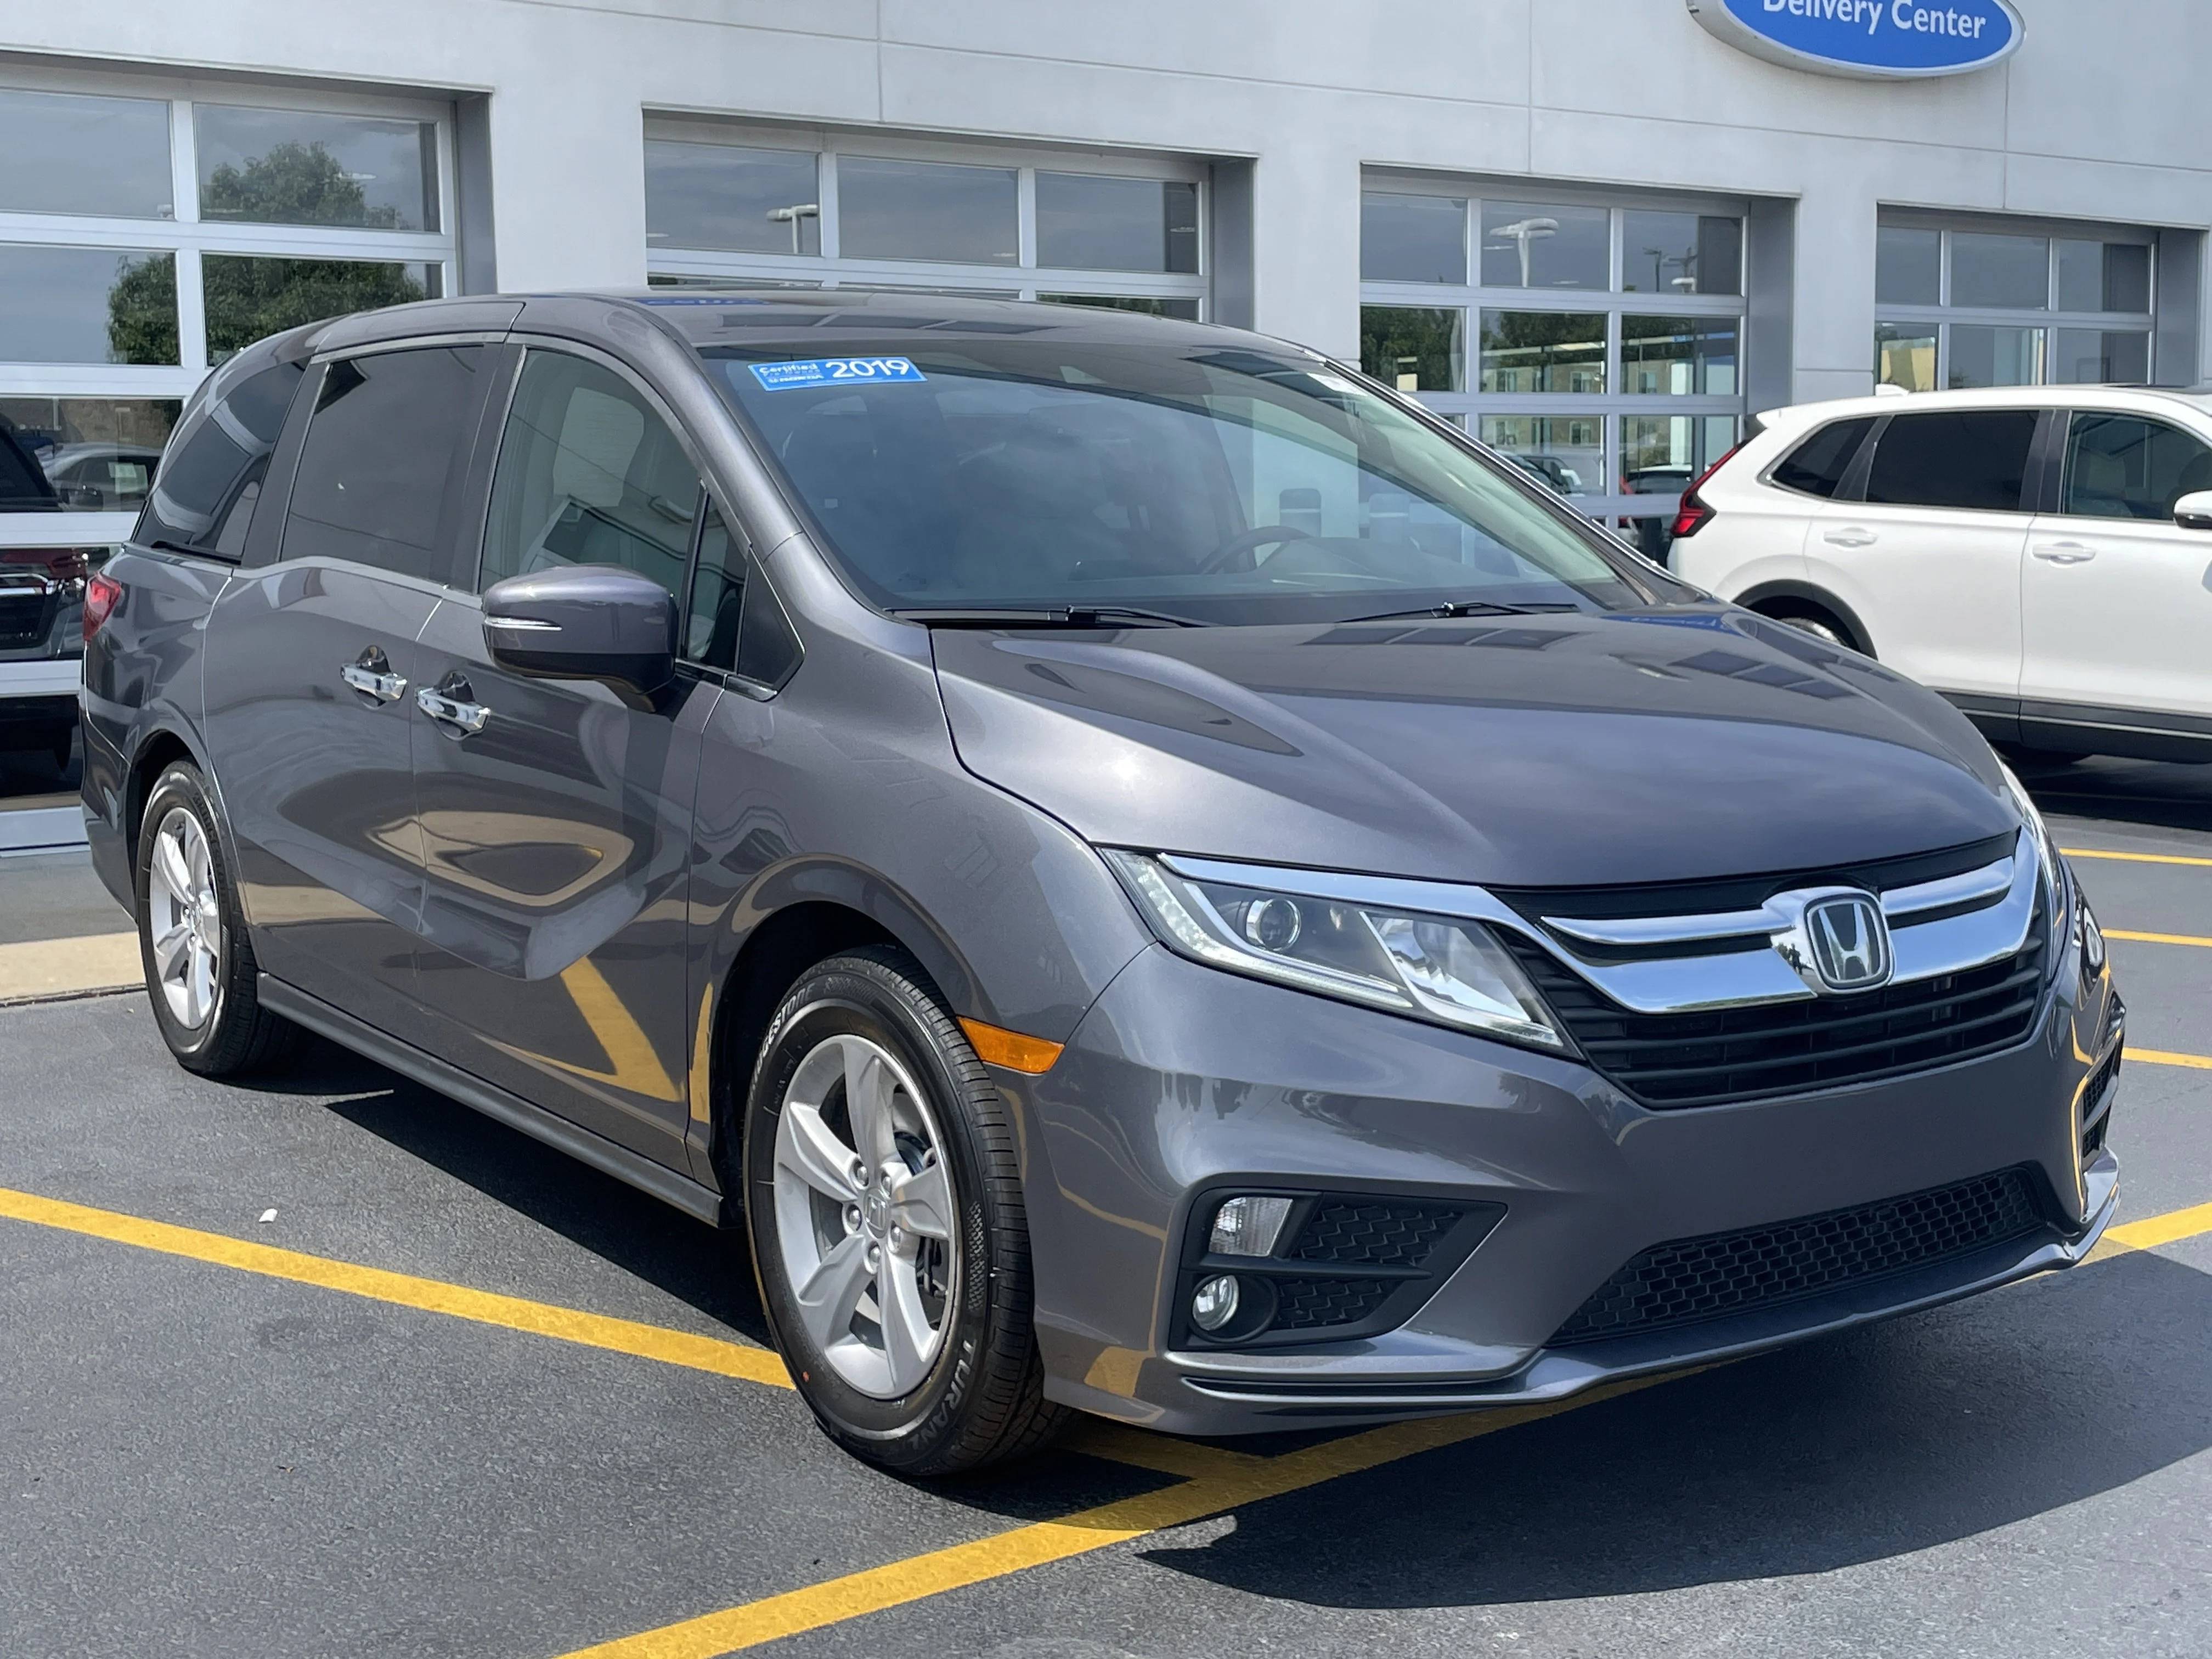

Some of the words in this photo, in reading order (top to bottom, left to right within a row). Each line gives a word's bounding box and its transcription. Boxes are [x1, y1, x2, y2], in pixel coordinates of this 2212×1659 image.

[1892, 0, 1986, 38] Center
[825, 359, 909, 378] 2019
[898, 1339, 978, 1454] TURANZ
